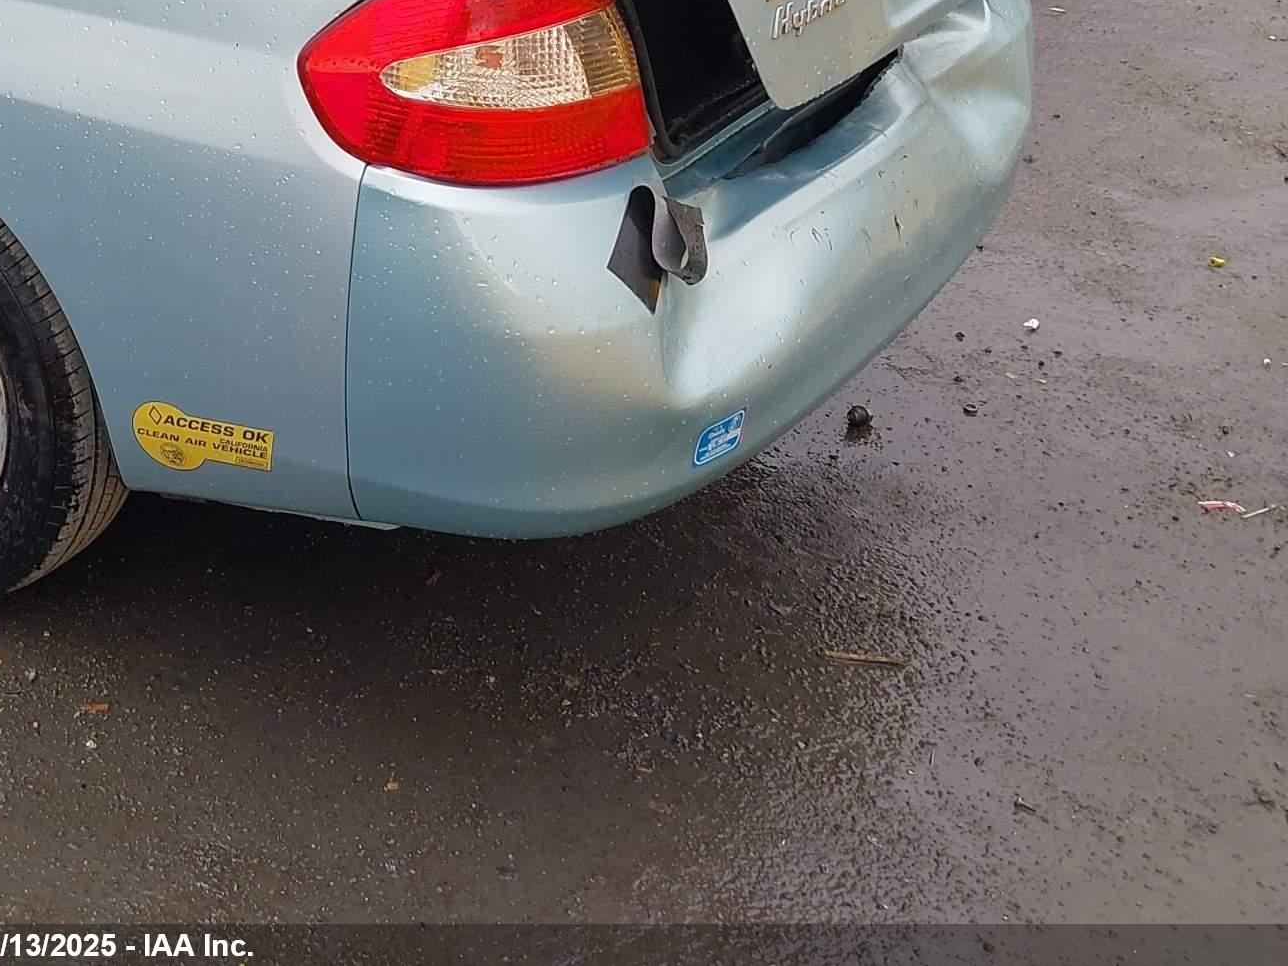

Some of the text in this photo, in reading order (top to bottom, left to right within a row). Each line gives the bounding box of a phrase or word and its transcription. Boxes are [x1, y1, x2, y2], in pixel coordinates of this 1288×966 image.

[137, 427, 268, 459] CLEAN AIR VEHICLE
[163, 415, 269, 444] ACCESS OK
[219, 438, 268, 453] CALIFORNIA
